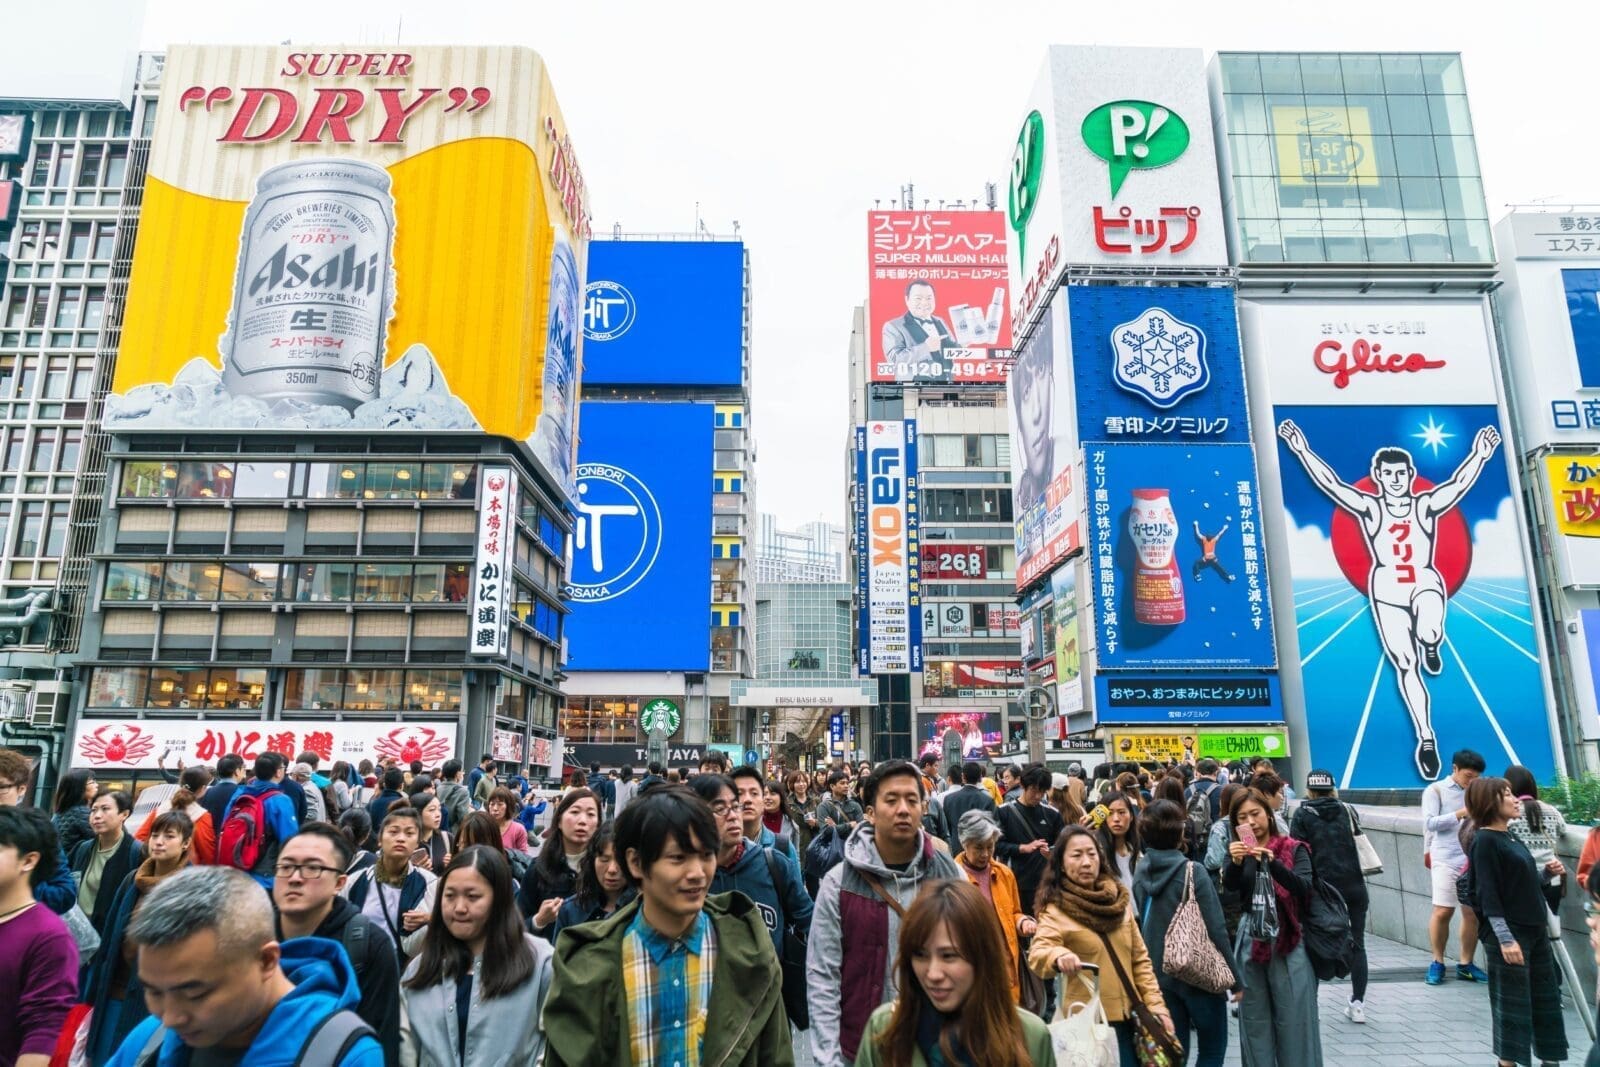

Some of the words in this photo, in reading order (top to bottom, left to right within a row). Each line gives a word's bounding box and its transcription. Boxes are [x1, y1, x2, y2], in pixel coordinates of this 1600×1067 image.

[281, 53, 413, 77] SUPER
[1110, 106, 1169, 158] P!
[272, 213, 293, 232] ASAHI
[296, 202, 342, 216] BREWERIES
[344, 210, 368, 233] LIMITED
[874, 214, 951, 231] スーパー
[1093, 206, 1201, 254] ピップ
[874, 233, 1007, 250] ミリオンヘアー
[1548, 239, 1600, 251] エステ
[874, 253, 921, 263] SUPER
[926, 254, 976, 263] MILLION
[249, 243, 378, 297] Asahi
[290, 309, 327, 331] 生
[270, 336, 344, 349] スーパードライ
[1314, 339, 1446, 388] Glico
[286, 372, 318, 384] 350ml
[1104, 416, 1229, 434] 雪印メグミルク
[484, 496, 503, 556] 本場の味
[1133, 523, 1163, 537] ガセリ
[1093, 451, 1117, 655] ガセリ菌SP株が内臓脂肪を減らす
[1237, 481, 1263, 630] 運動が内臓脂肪を減らす
[1388, 520, 1416, 583] グリコ
[875, 570, 901, 578] Japan
[875, 578, 901, 586] Quality
[1072, 740, 1094, 748] Toilets
[1226, 737, 1261, 752] ピタットハウス
